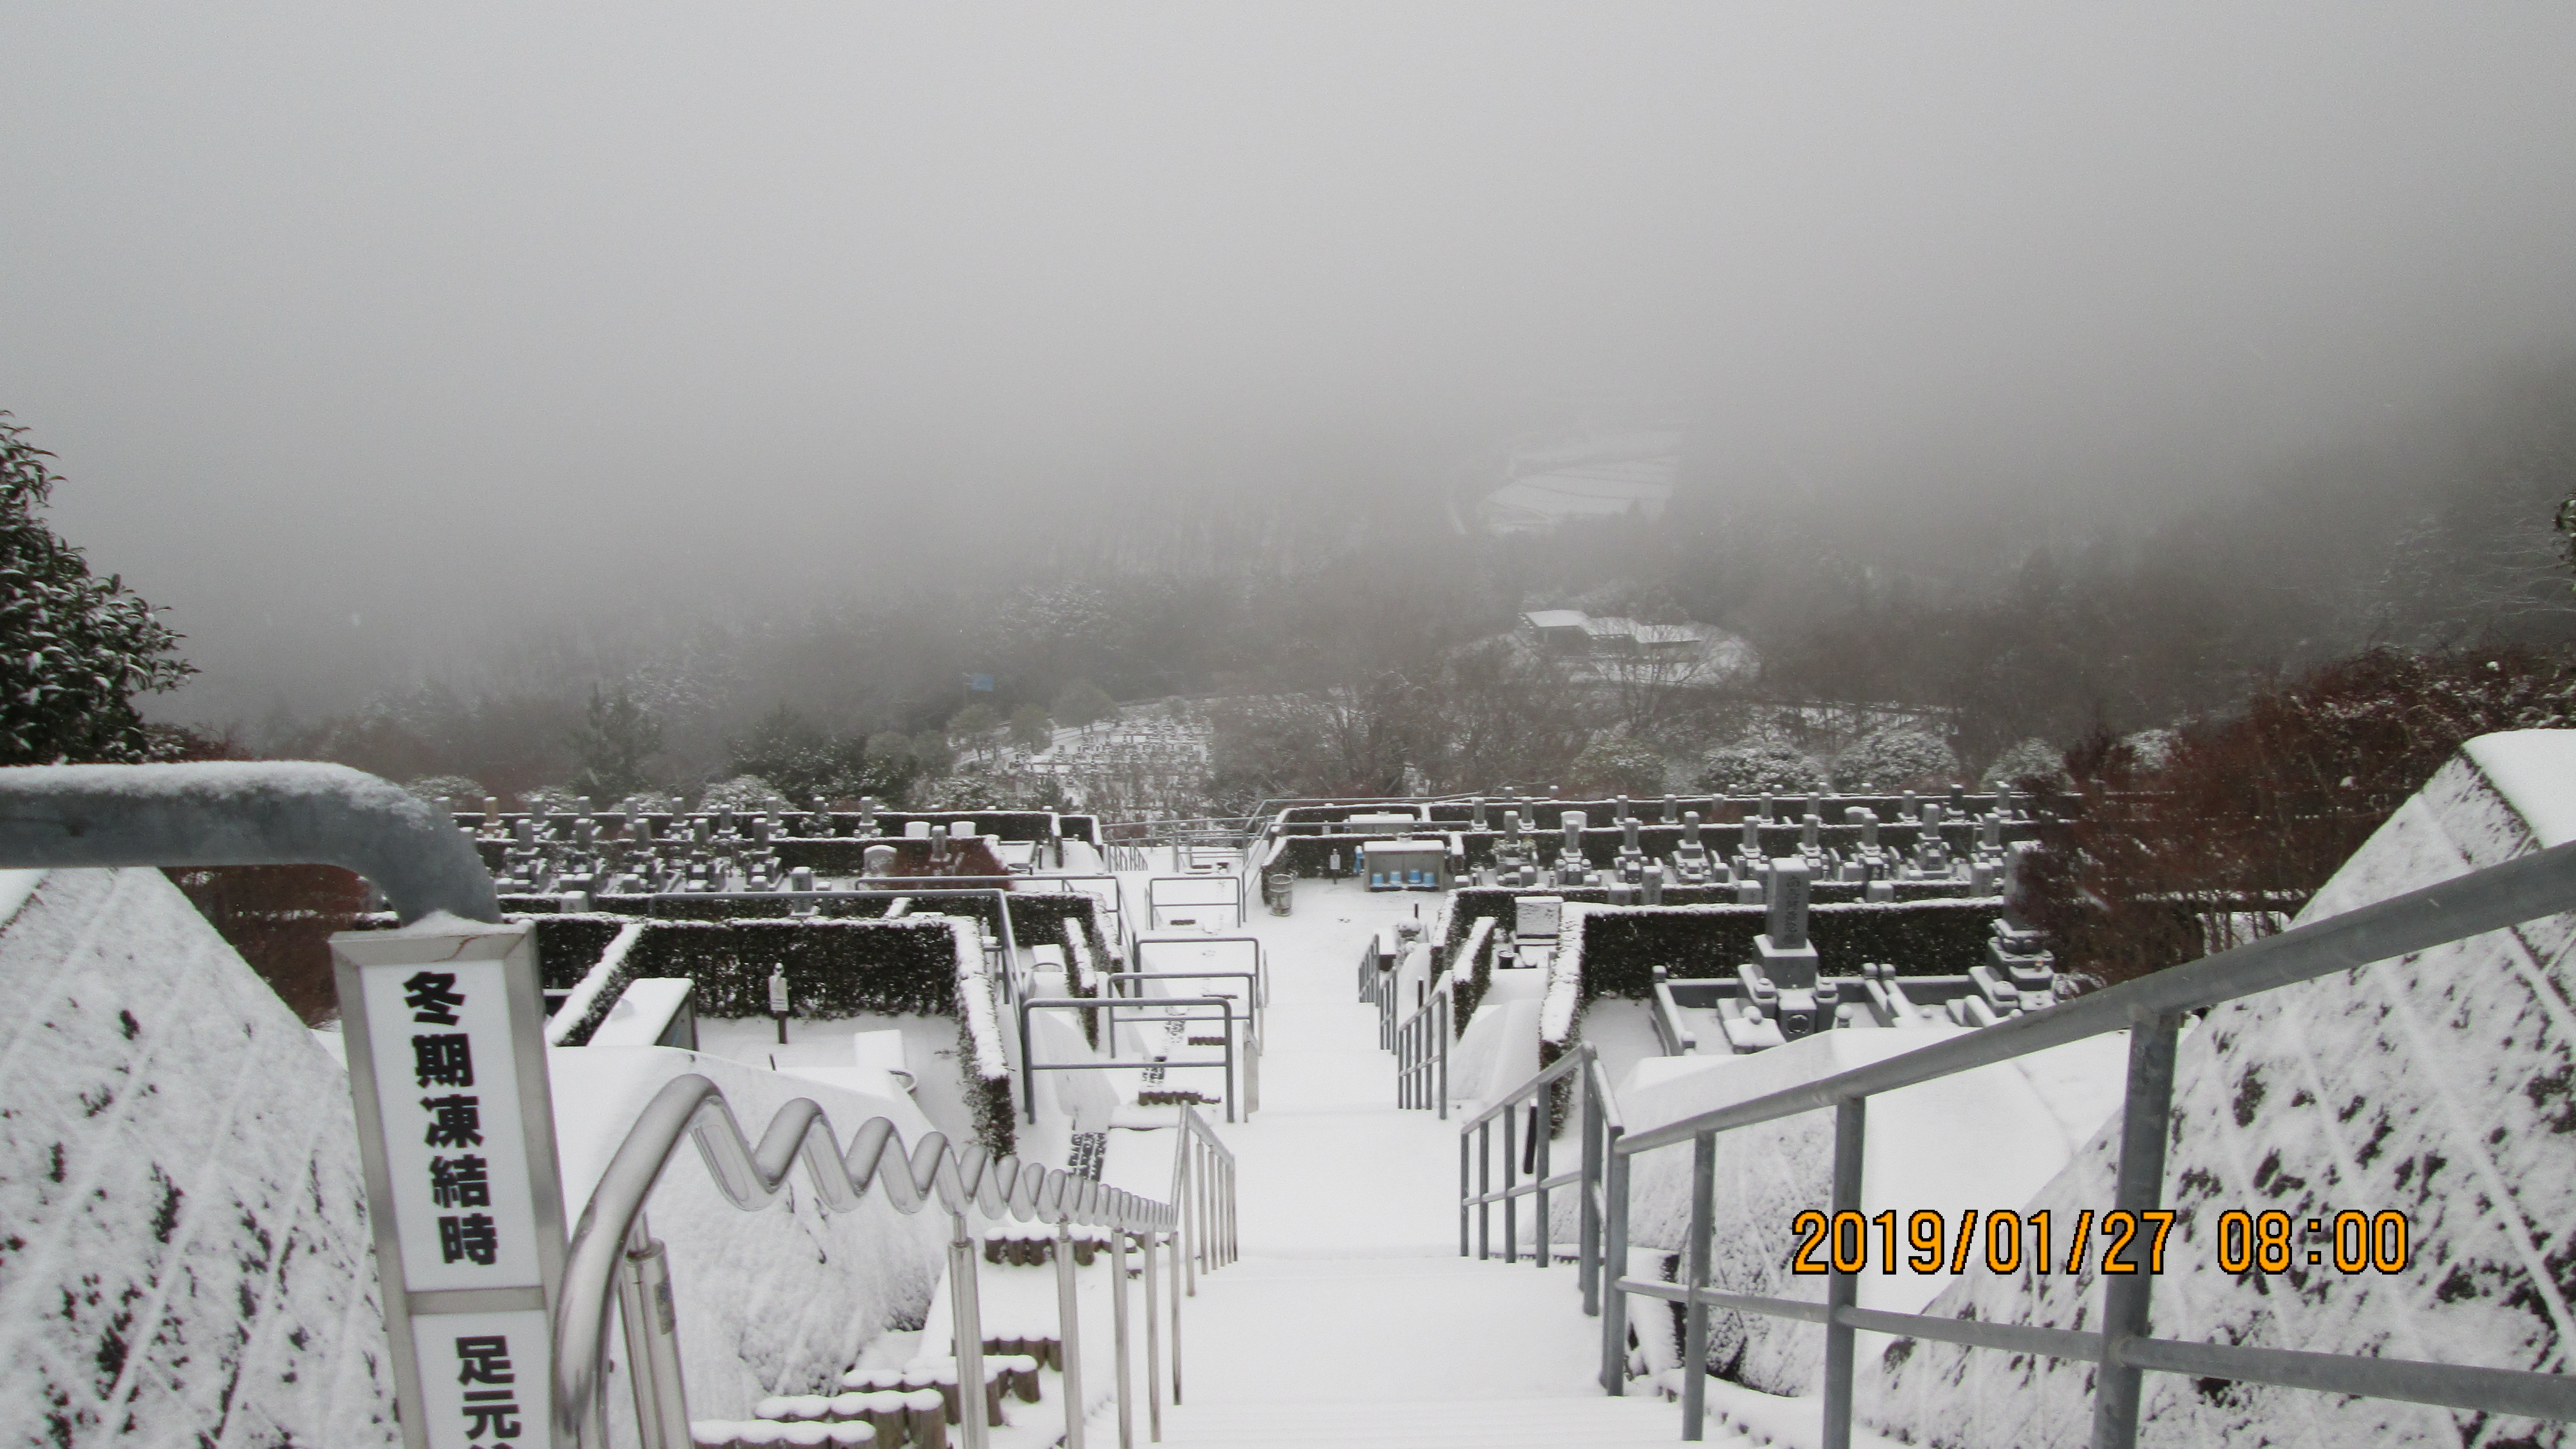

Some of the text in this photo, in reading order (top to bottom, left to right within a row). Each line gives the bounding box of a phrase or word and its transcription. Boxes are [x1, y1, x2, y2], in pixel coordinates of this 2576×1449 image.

[402, 971, 498, 1266] 冬期凍結時
[455, 1335, 522, 1449] 足元
